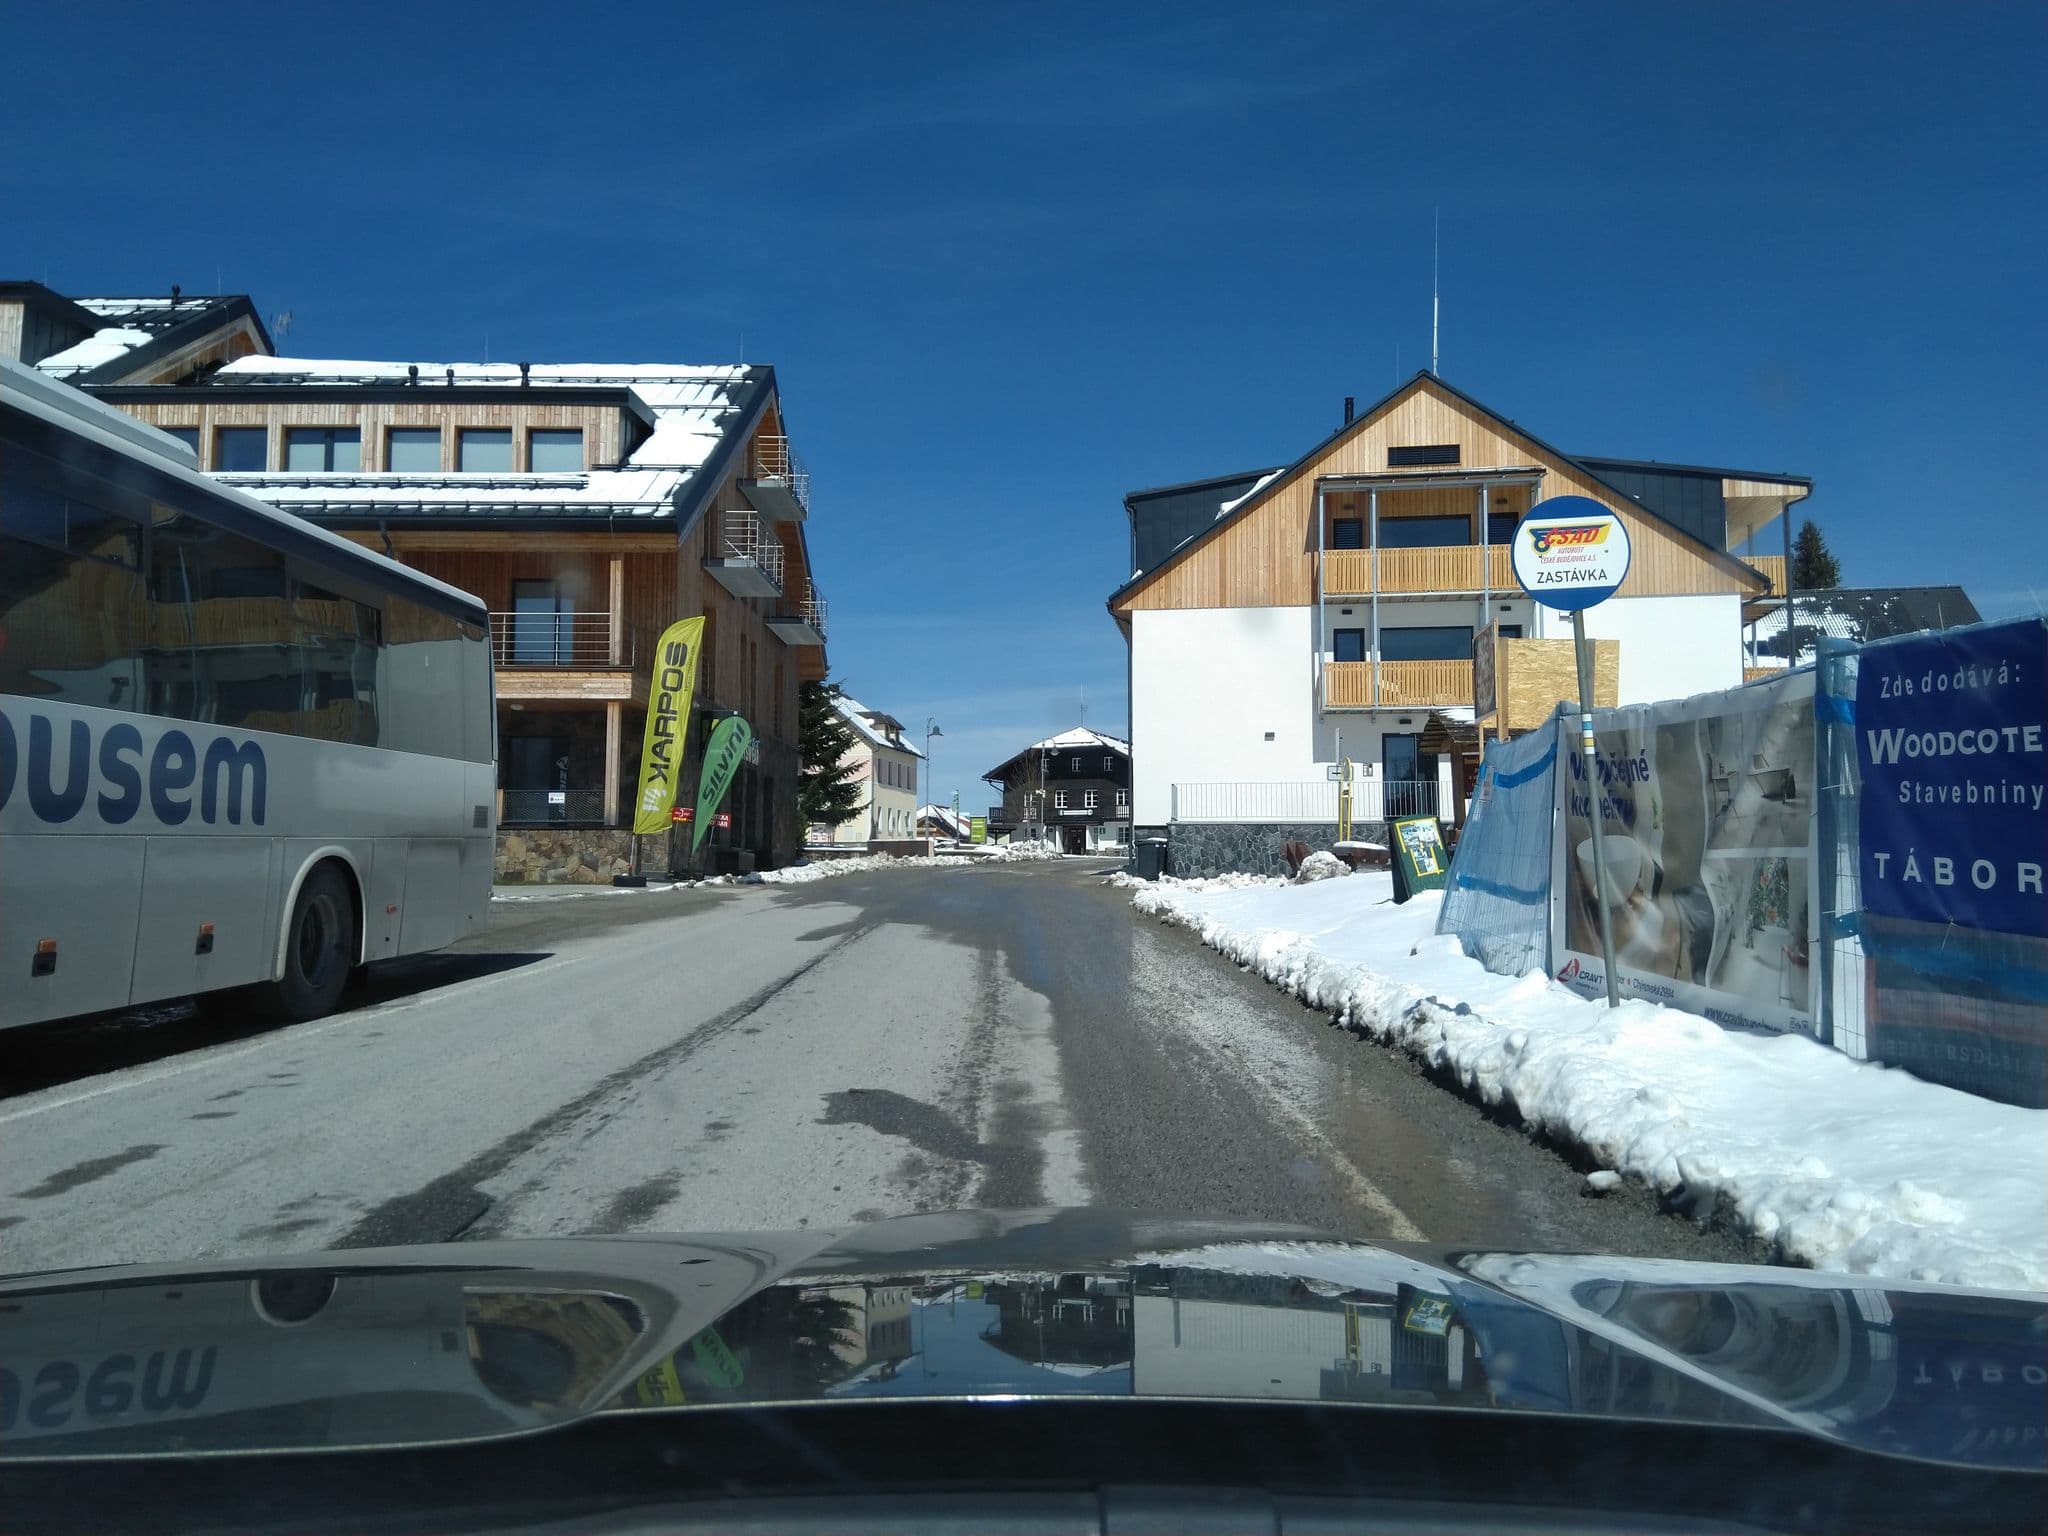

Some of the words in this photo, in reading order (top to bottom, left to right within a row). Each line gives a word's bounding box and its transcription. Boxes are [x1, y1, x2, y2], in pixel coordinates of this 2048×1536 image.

[1536, 568, 1608, 584] ZASTÁVKA
[1880, 674, 1913, 699] Zde
[1921, 660, 2022, 694] dodává:
[648, 641, 688, 784] KARPOS
[703, 722, 745, 801] SILVINI
[1867, 725, 2043, 765] WOODCOTE
[0, 709, 267, 826] usem
[1899, 780, 2044, 810] Stavebniny
[1874, 847, 2043, 895] TÁBOR
[1579, 970, 1604, 985] CRAVT
